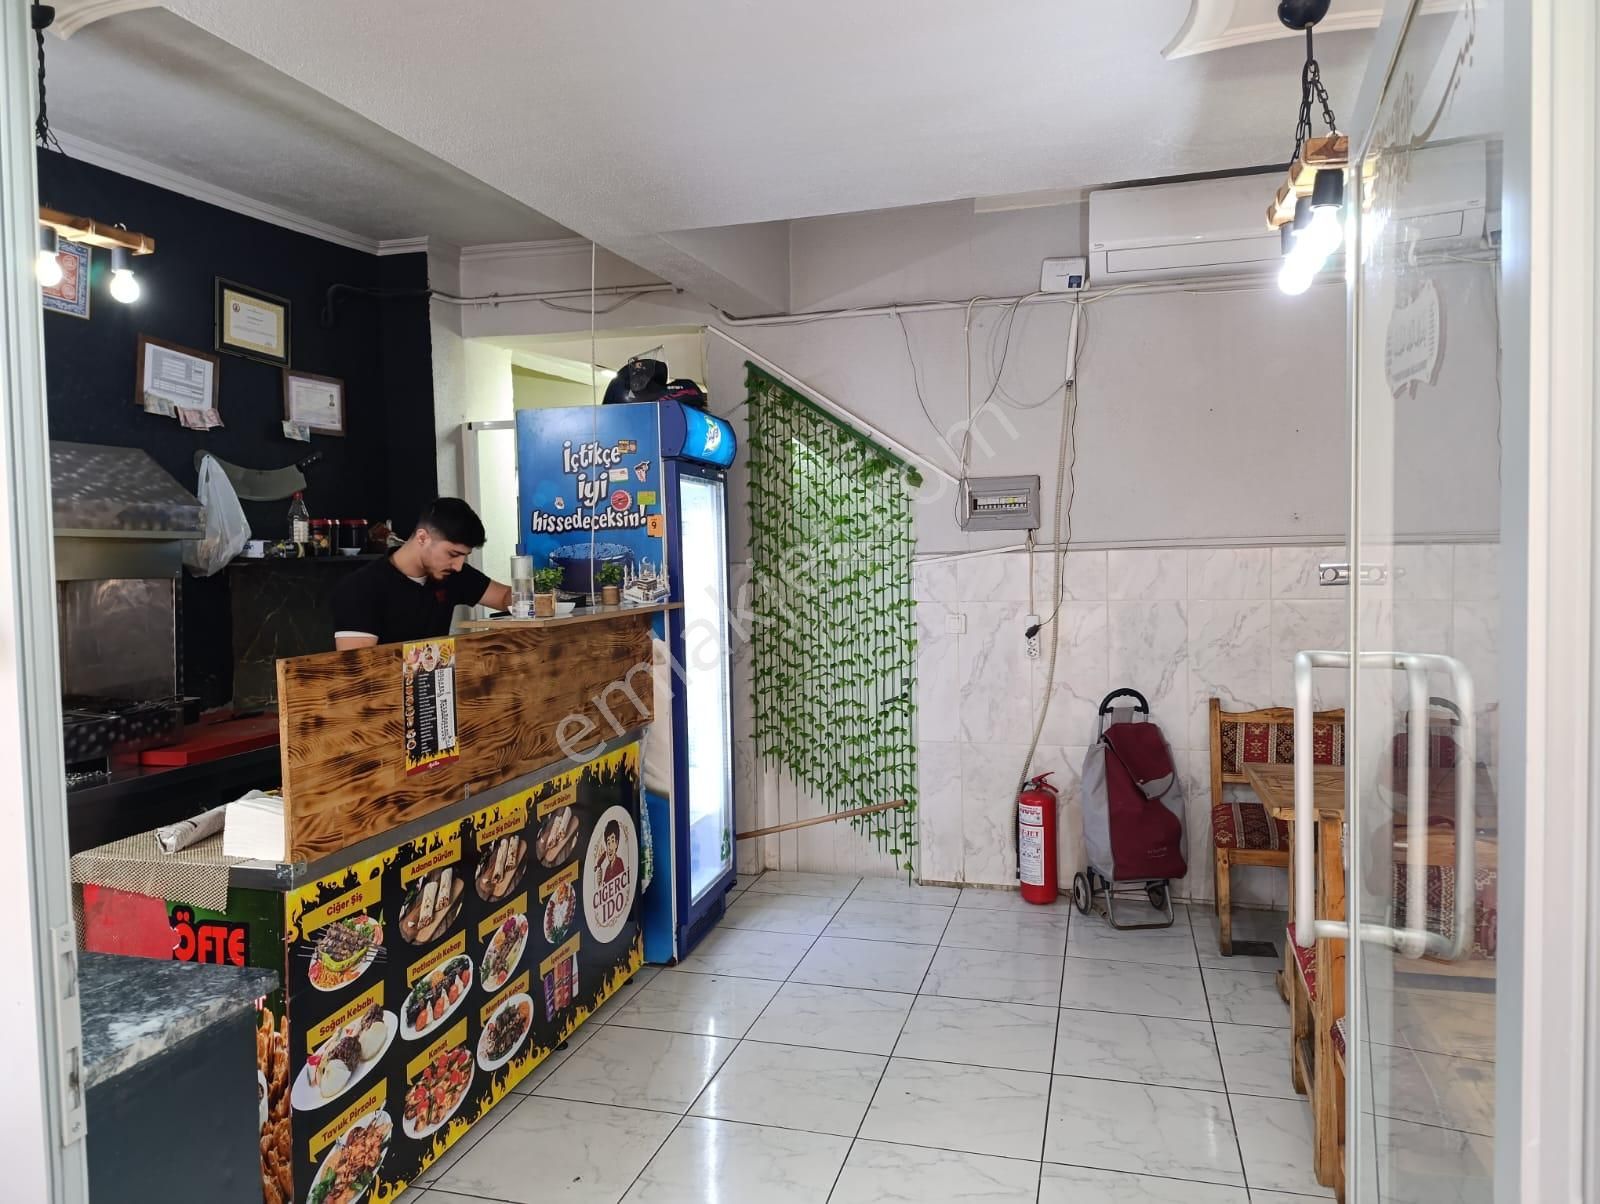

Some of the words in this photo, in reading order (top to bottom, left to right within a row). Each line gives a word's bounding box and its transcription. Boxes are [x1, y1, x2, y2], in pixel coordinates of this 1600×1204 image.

[562, 439, 622, 473] İçtikçe
[577, 471, 609, 506] iyi
[532, 504, 647, 533] hissedeceksin!
[411, 860, 433, 876] Adana
[432, 849, 454, 864] Dürüm
[326, 898, 350, 916] Ciğer
[350, 892, 363, 906] Şiş
[319, 1013, 346, 1037] Soğan
[348, 996, 375, 1018] Kebabı
[428, 1039, 448, 1060] Kanat
[321, 1118, 349, 1143] Tavuk
[349, 1095, 377, 1121] Pirzola
